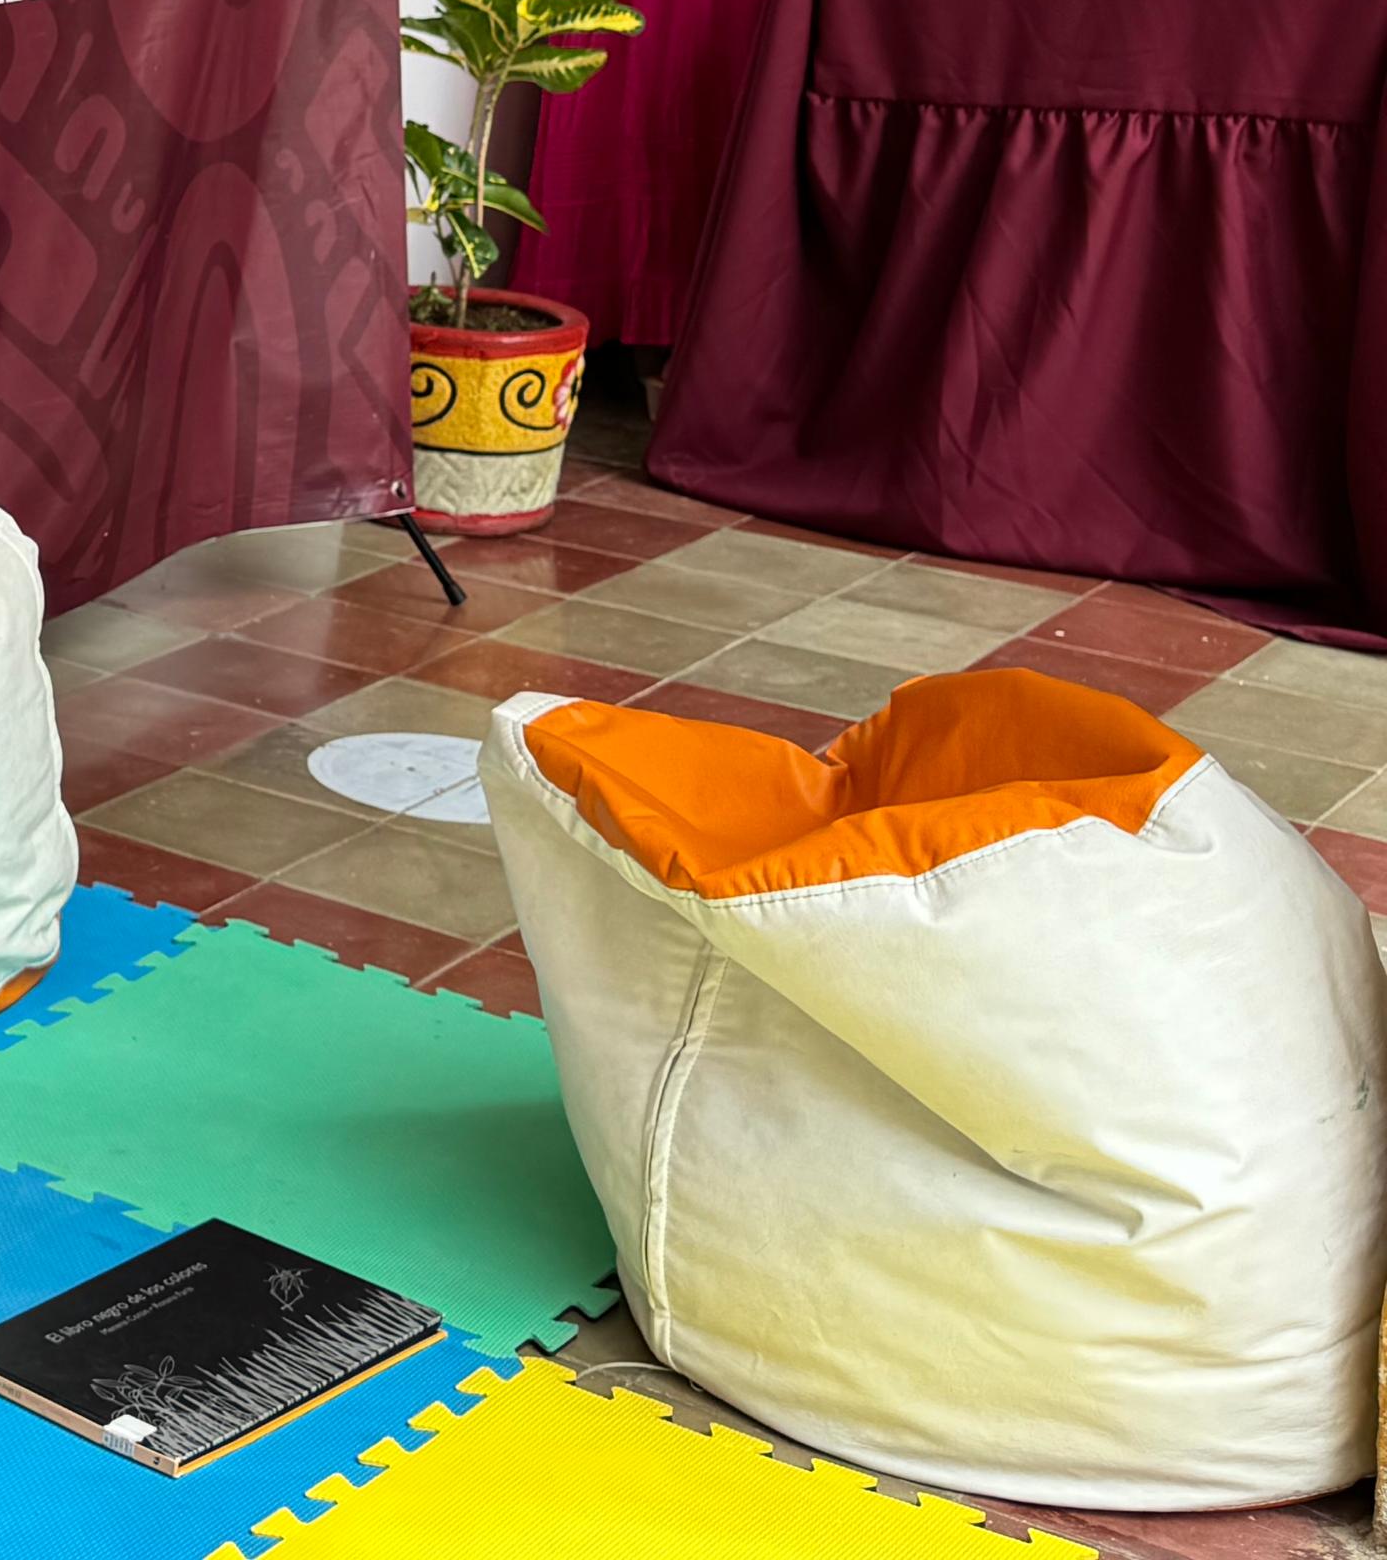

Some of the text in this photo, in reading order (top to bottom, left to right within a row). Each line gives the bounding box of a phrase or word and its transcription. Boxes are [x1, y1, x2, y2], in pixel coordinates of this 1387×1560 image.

[45, 1261, 208, 1344] El libro negro de los colores
